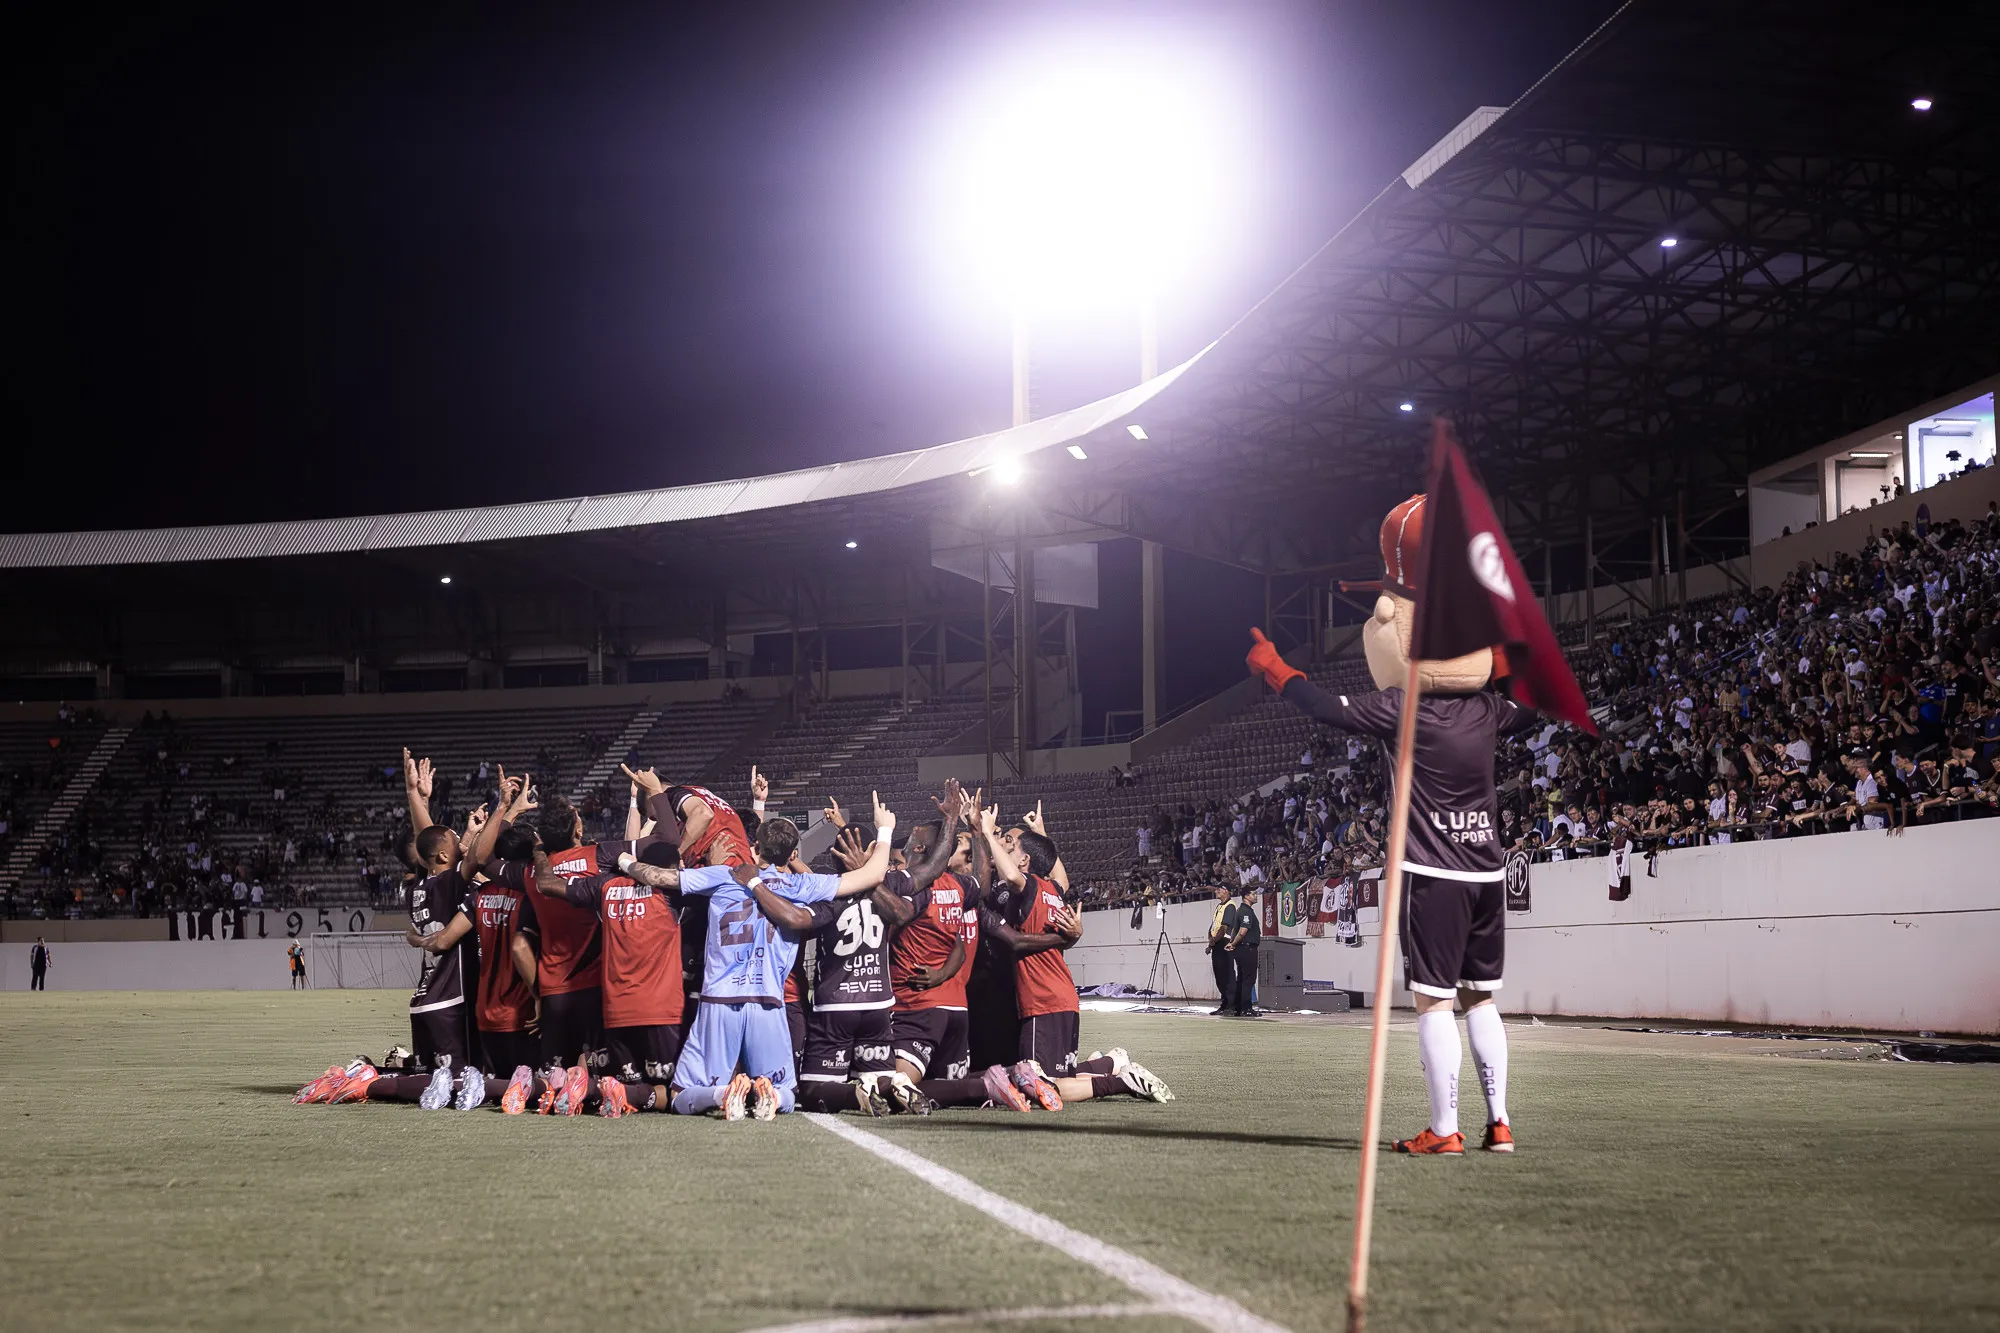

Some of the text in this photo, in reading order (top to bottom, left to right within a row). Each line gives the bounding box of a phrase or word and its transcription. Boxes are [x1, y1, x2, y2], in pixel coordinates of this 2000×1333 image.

[1430, 811, 1490, 833] LUPO
[1451, 829, 1494, 843] SPORT
[256, 908, 365, 938] 1950
[834, 899, 884, 956] 36
[1450, 1074, 1458, 1108] LUPO
[1482, 1063, 1495, 1096] LUPO
